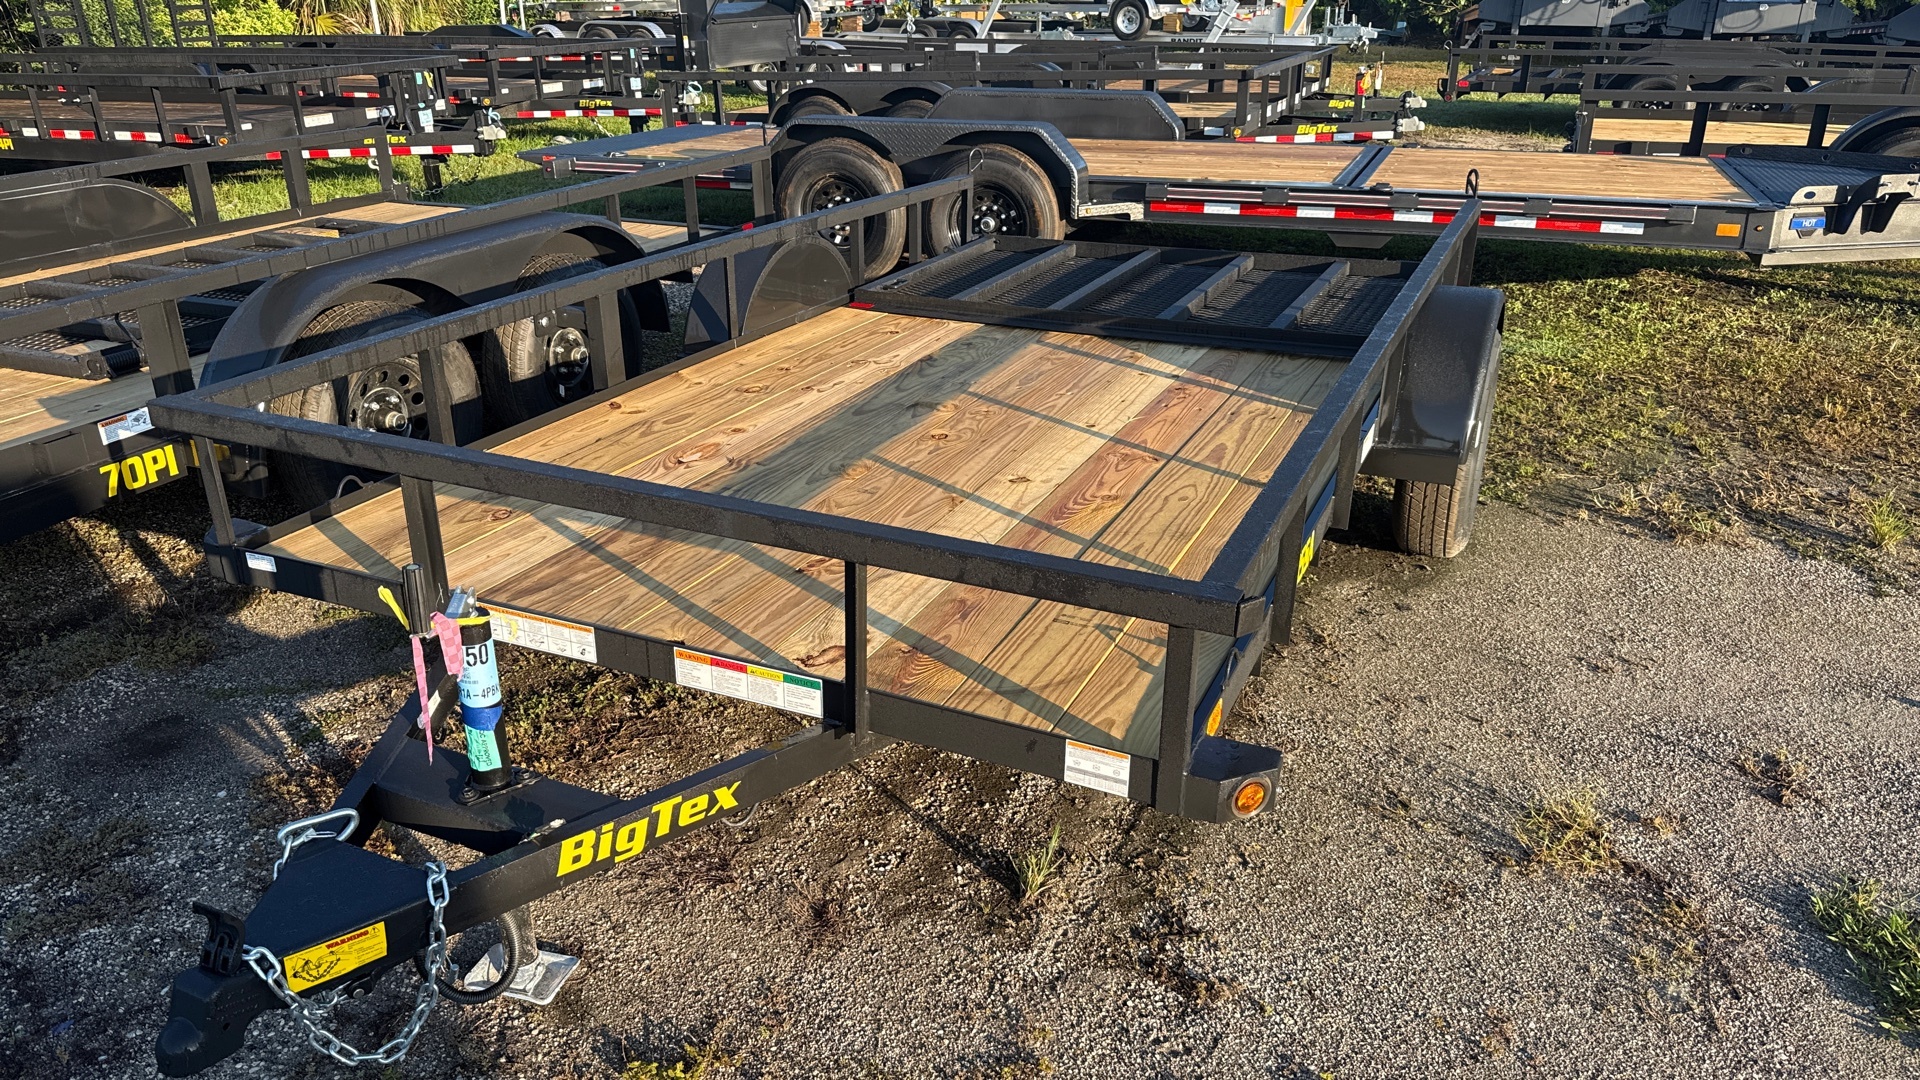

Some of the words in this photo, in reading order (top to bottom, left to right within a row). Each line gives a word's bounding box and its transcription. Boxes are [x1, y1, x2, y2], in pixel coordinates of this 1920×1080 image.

[579, 99, 613, 109] BigTex
[1328, 99, 1355, 109] BigTe
[1296, 124, 1338, 135] BigTex
[99, 444, 179, 497] 70PI
[678, 651, 709, 664] WARNING
[720, 662, 745, 673] DANGER
[754, 670, 782, 681] CAUTION
[789, 677, 817, 689] NOTICE
[556, 780, 742, 877] BigTex
[325, 929, 370, 950] WARNING
